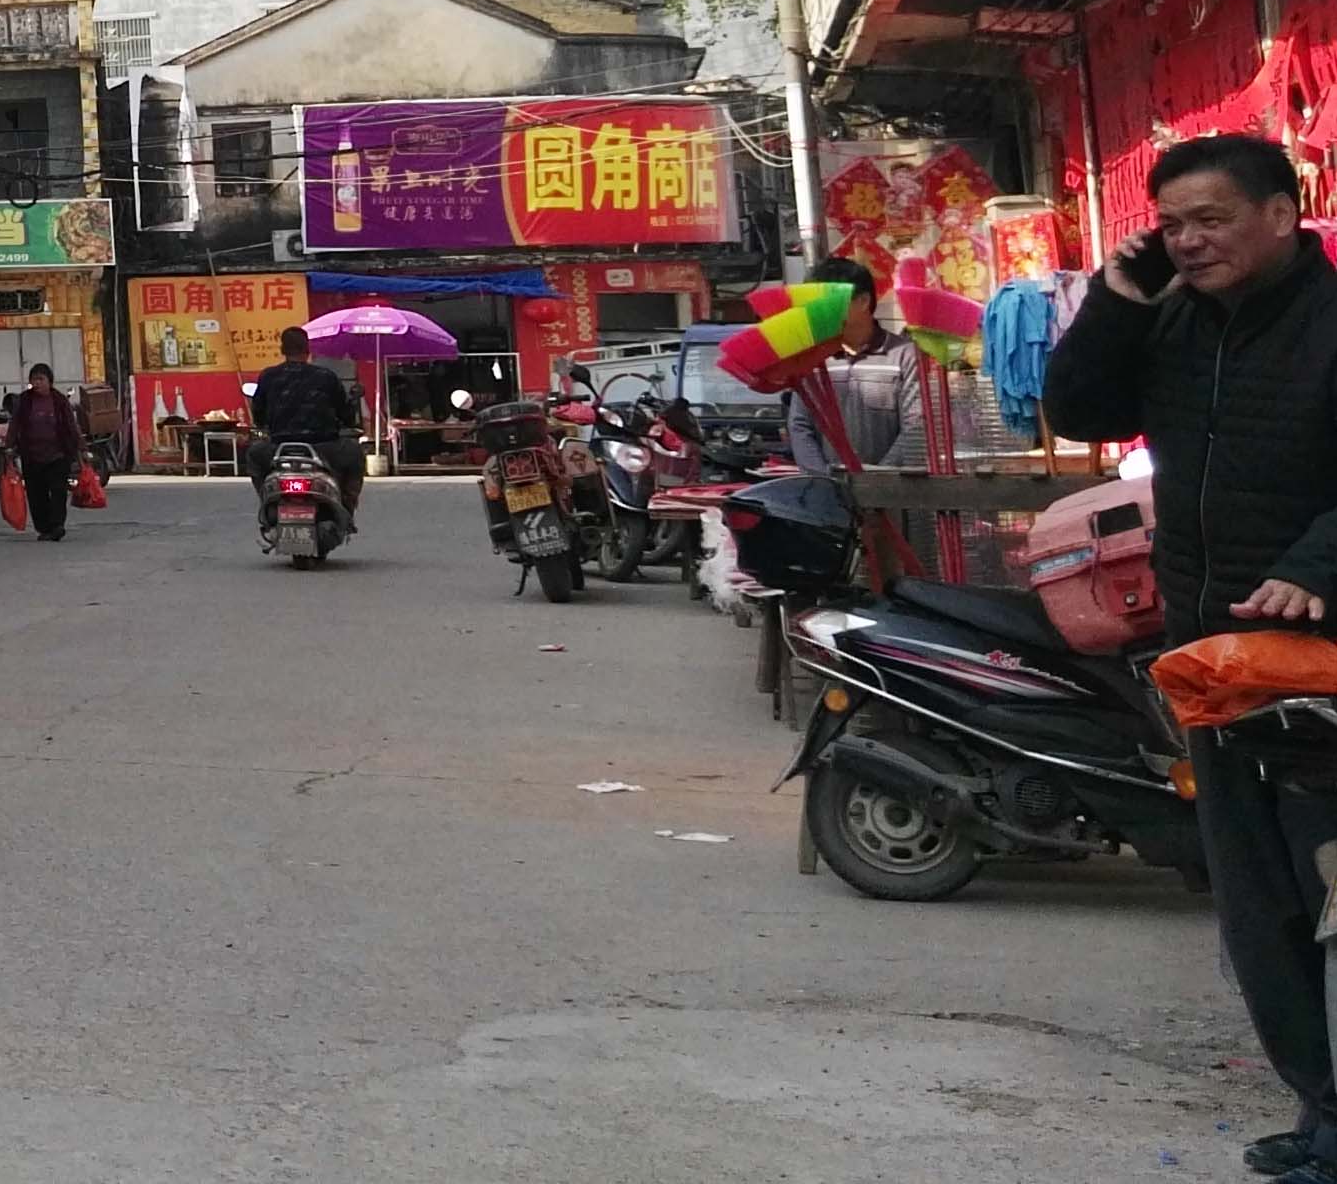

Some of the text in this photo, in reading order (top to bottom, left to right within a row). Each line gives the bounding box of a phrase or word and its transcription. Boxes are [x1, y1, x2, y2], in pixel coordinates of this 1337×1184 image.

[525, 123, 718, 213] 圆角商店
[142, 278, 294, 315] 圆角商店
